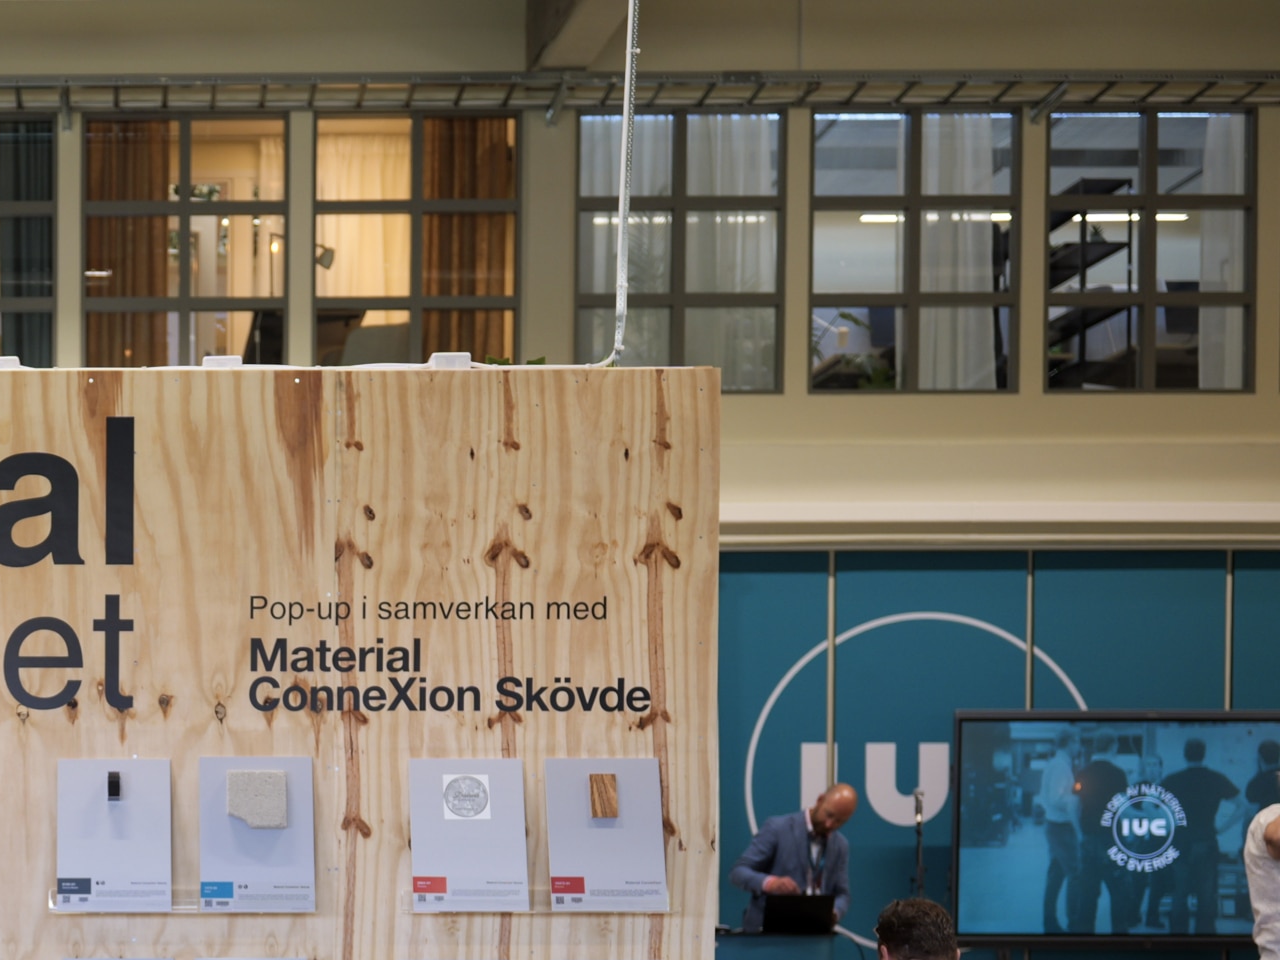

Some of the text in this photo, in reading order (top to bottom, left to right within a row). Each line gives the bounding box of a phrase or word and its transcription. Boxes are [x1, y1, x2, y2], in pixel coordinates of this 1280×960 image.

[249, 595, 608, 626] Pop-up i samverkan med
[249, 637, 421, 673] Material
[248, 676, 651, 713] ConneXion Skövde
[800, 742, 950, 827] IU
[1121, 818, 1167, 837] IUC
[1107, 845, 1180, 872] IUC SVERIGE
